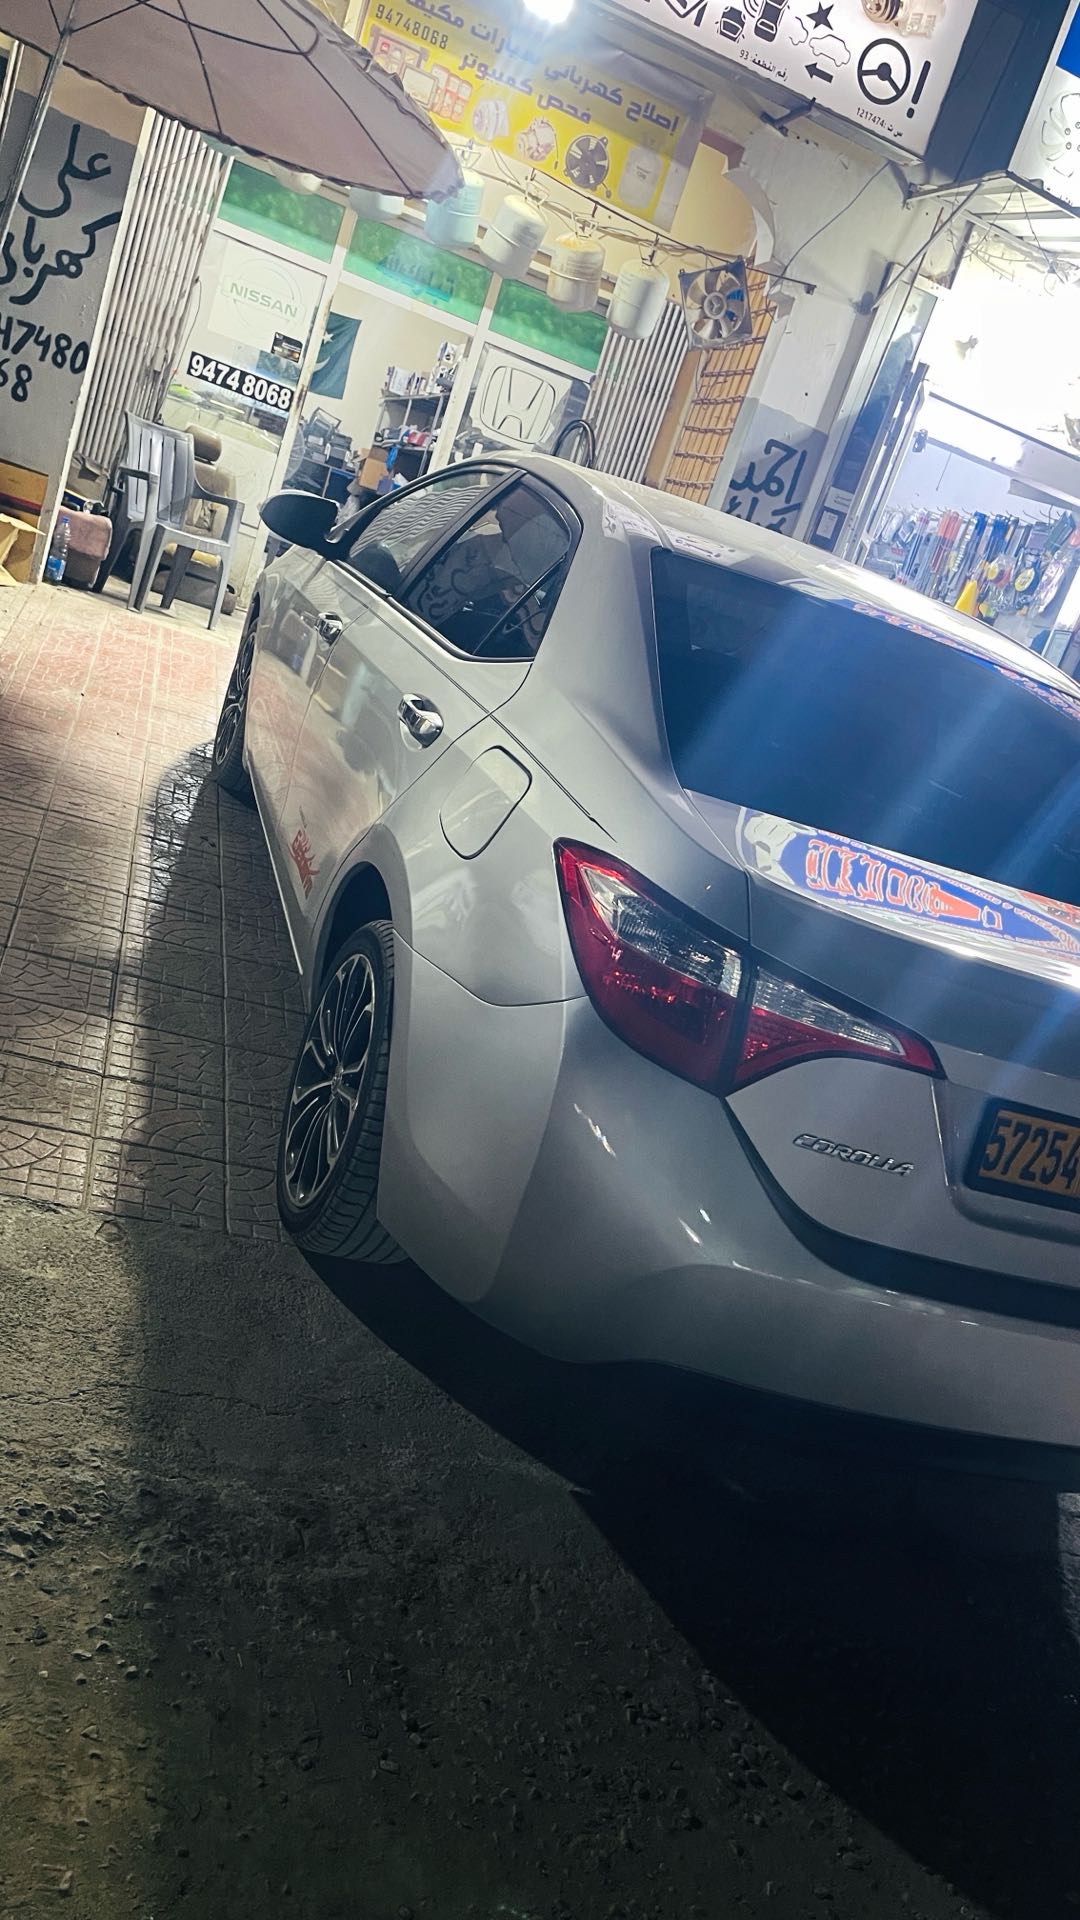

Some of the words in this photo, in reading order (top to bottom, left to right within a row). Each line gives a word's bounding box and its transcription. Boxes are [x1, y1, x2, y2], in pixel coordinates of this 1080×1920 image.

[375, 4, 449, 50] 94748068
[457, 52, 534, 96] كمبيوتر
[739, 49, 750, 60] 93
[536, 93, 593, 125] فحص
[625, 100, 680, 137] إصلاح
[228, 281, 299, 319] NISSAN
[793, 1133, 916, 1177] COROLLA
[982, 1117, 1080, 1190] 57254
